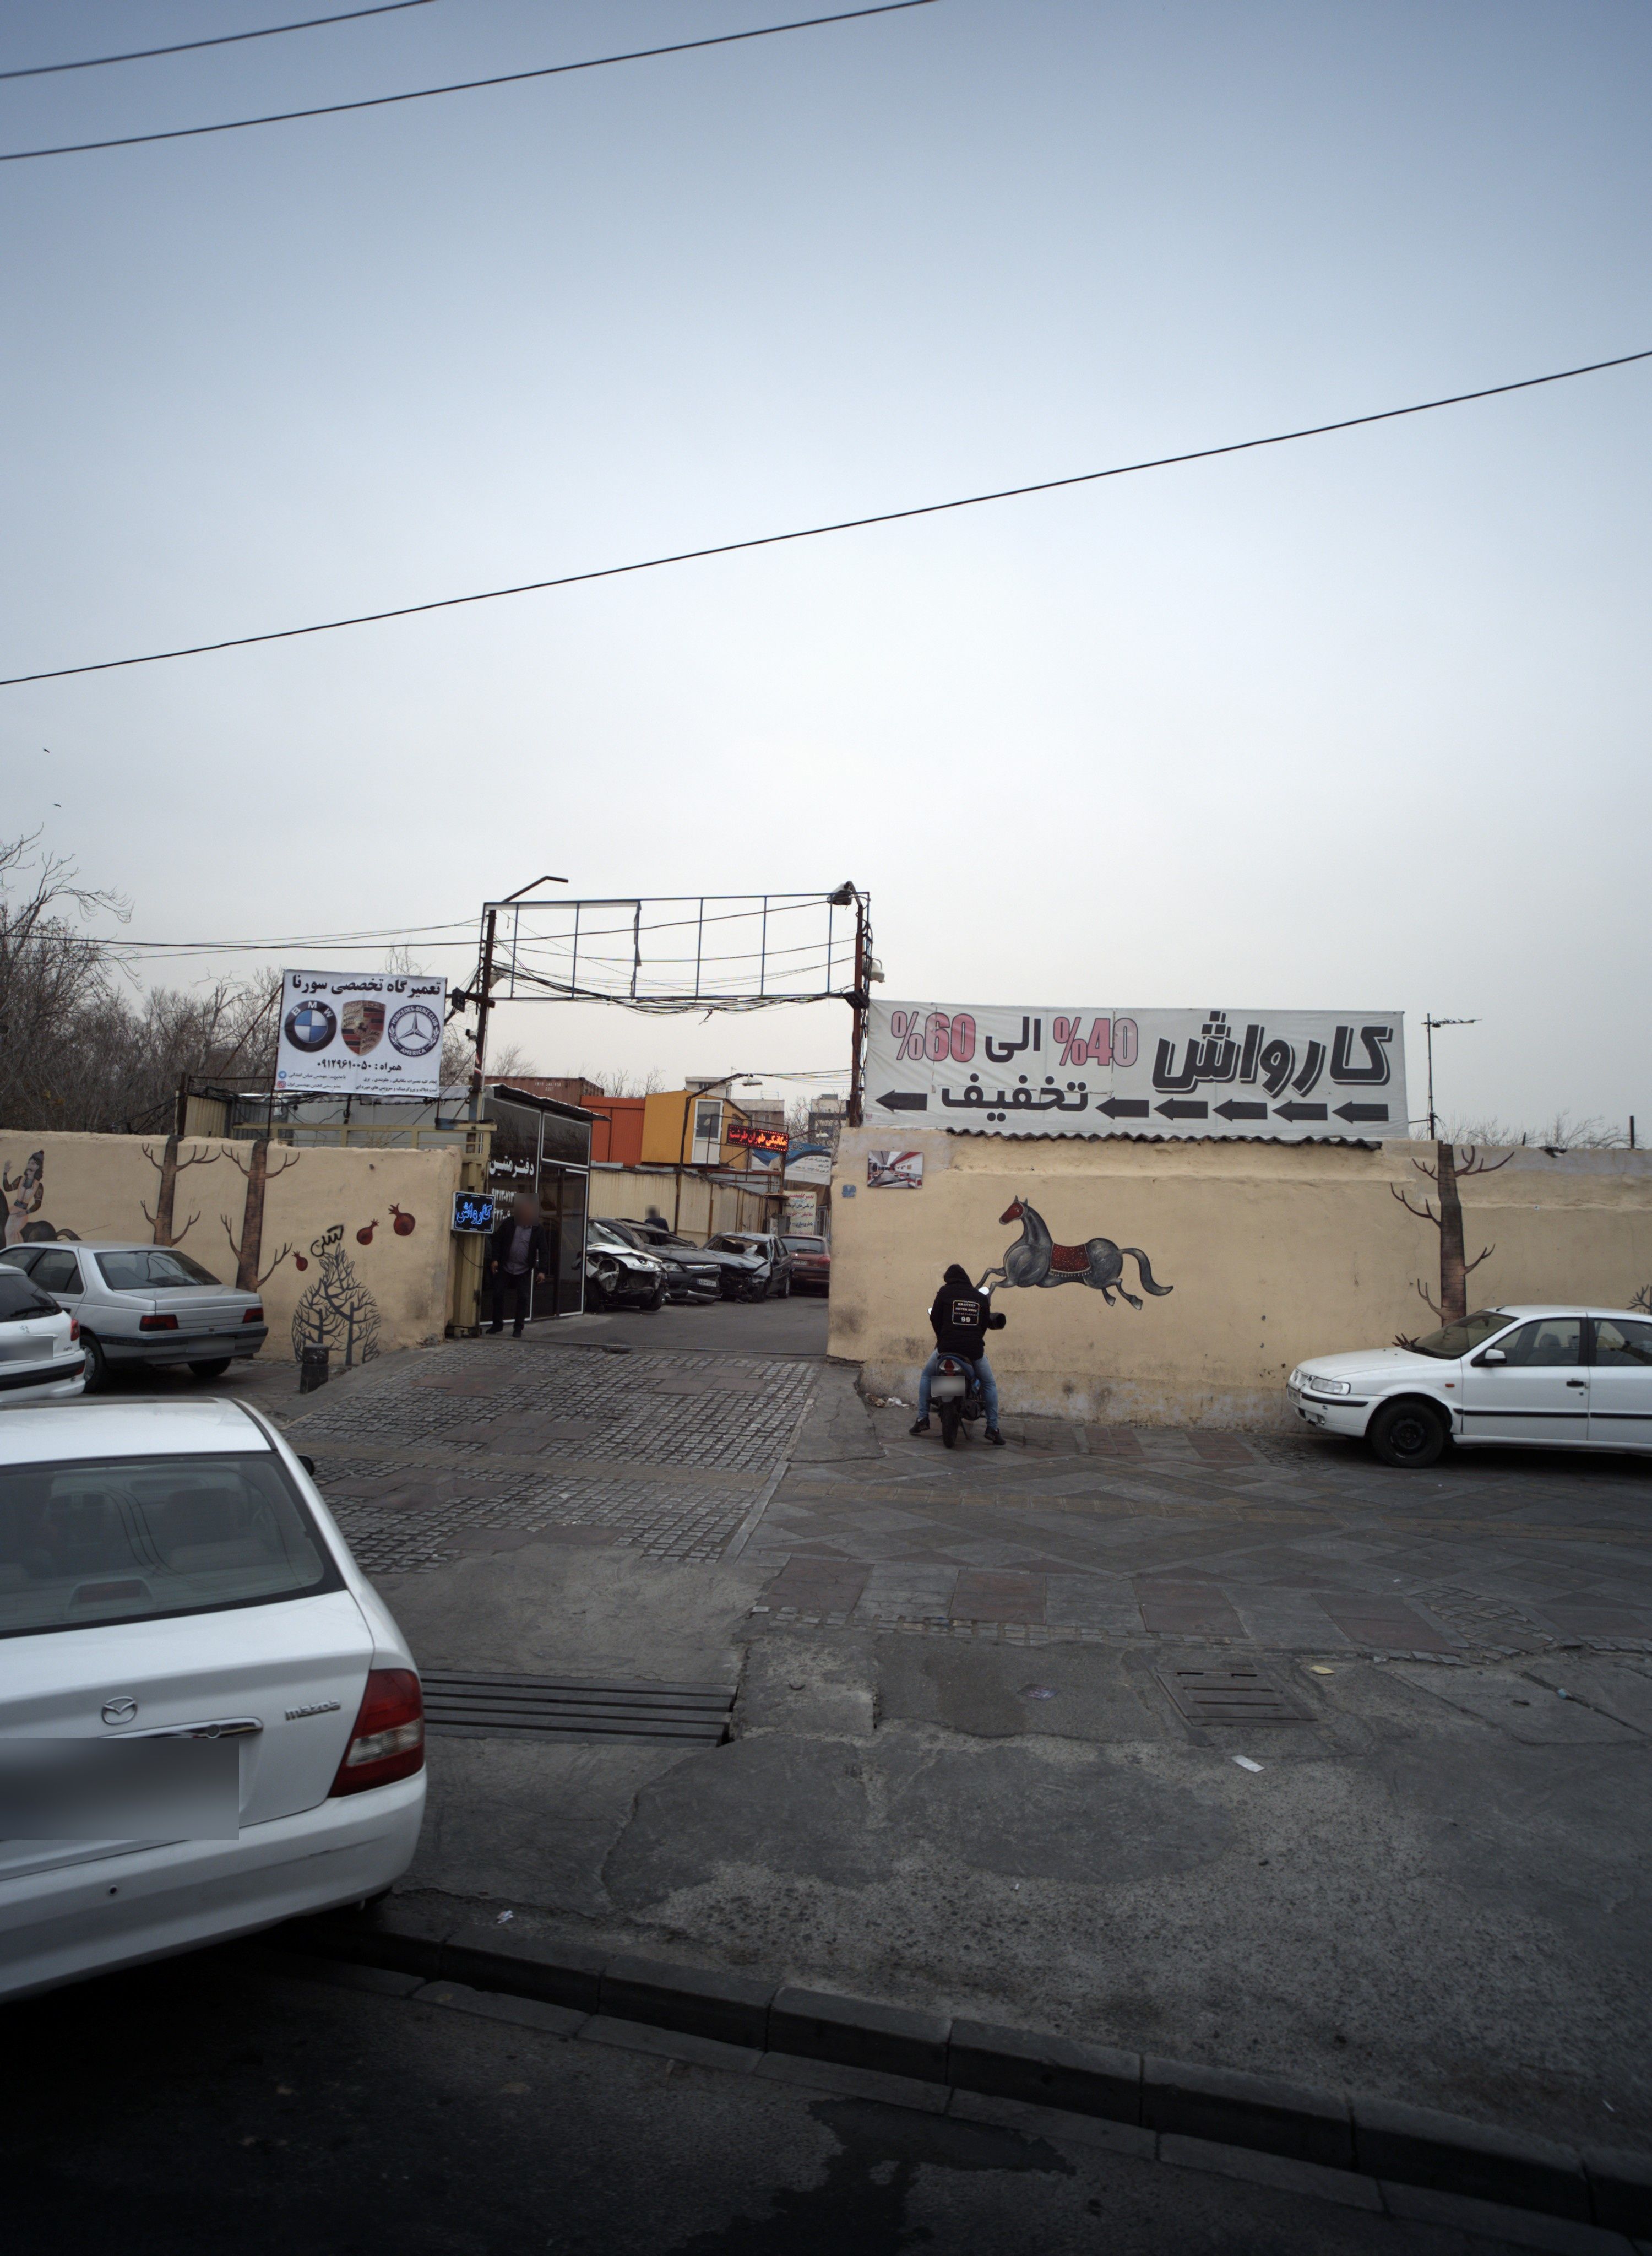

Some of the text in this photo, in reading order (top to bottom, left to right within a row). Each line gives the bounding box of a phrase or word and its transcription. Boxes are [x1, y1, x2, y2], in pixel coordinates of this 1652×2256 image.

[292, 974, 328, 994] سورنا
[331, 978, 384, 995] تخصصی
[291, 1001, 333, 1018] BMW
[400, 1048, 426, 1056] AMERICA
[890, 1010, 1393, 1099] کارواش %40 الی %60
[941, 1073, 1089, 1122] تخفیف
[512, 1157, 535, 1178] دفتر
[457, 1201, 493, 1225] کارواش
[285, 1700, 341, 1721] mazda
